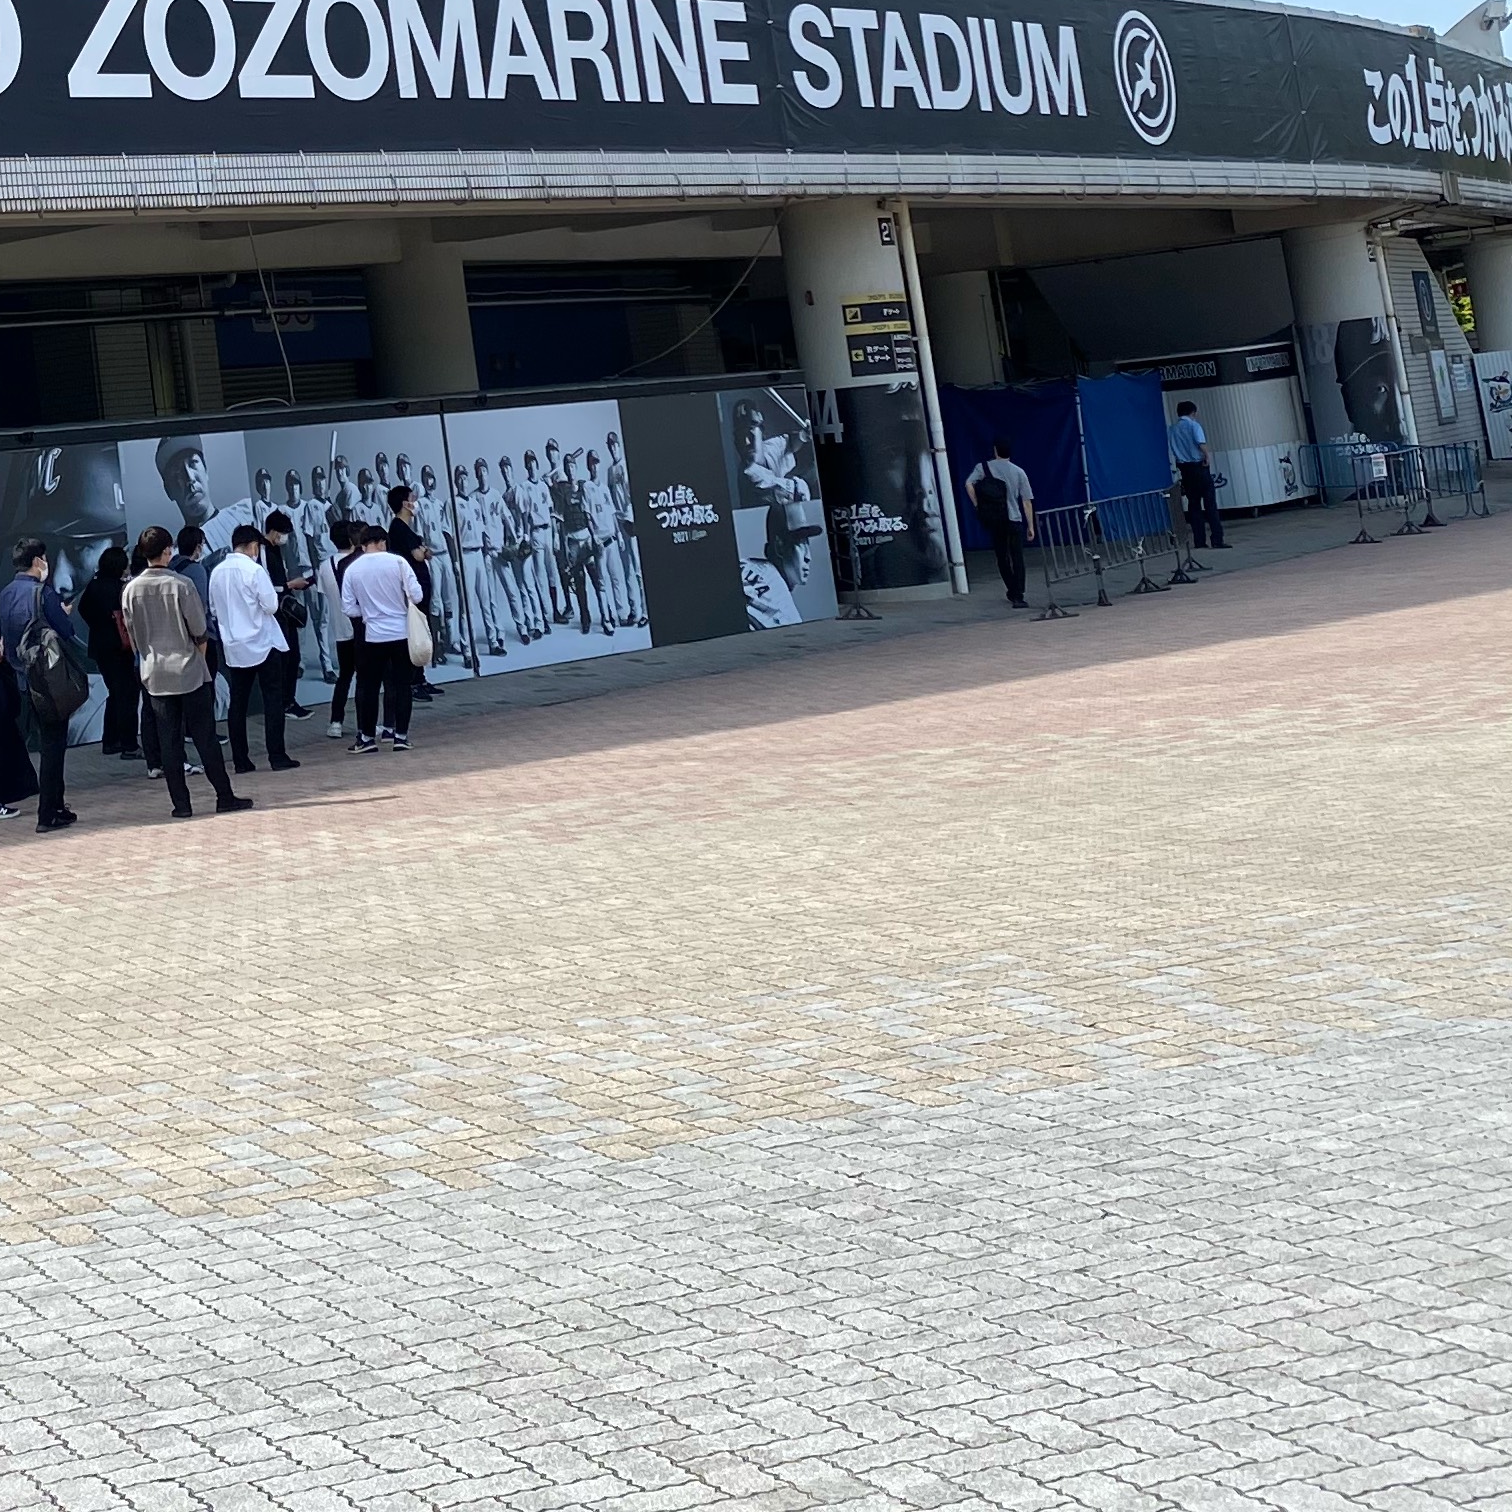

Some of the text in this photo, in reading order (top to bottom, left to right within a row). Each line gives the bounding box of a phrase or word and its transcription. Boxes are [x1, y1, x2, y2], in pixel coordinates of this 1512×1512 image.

[789, 4, 1087, 116] STADIUM
[1363, 54, 1512, 165] この1点を、つかみ
[648, 484, 698, 508] この1点を、
[656, 504, 719, 528] つかみ取る。
